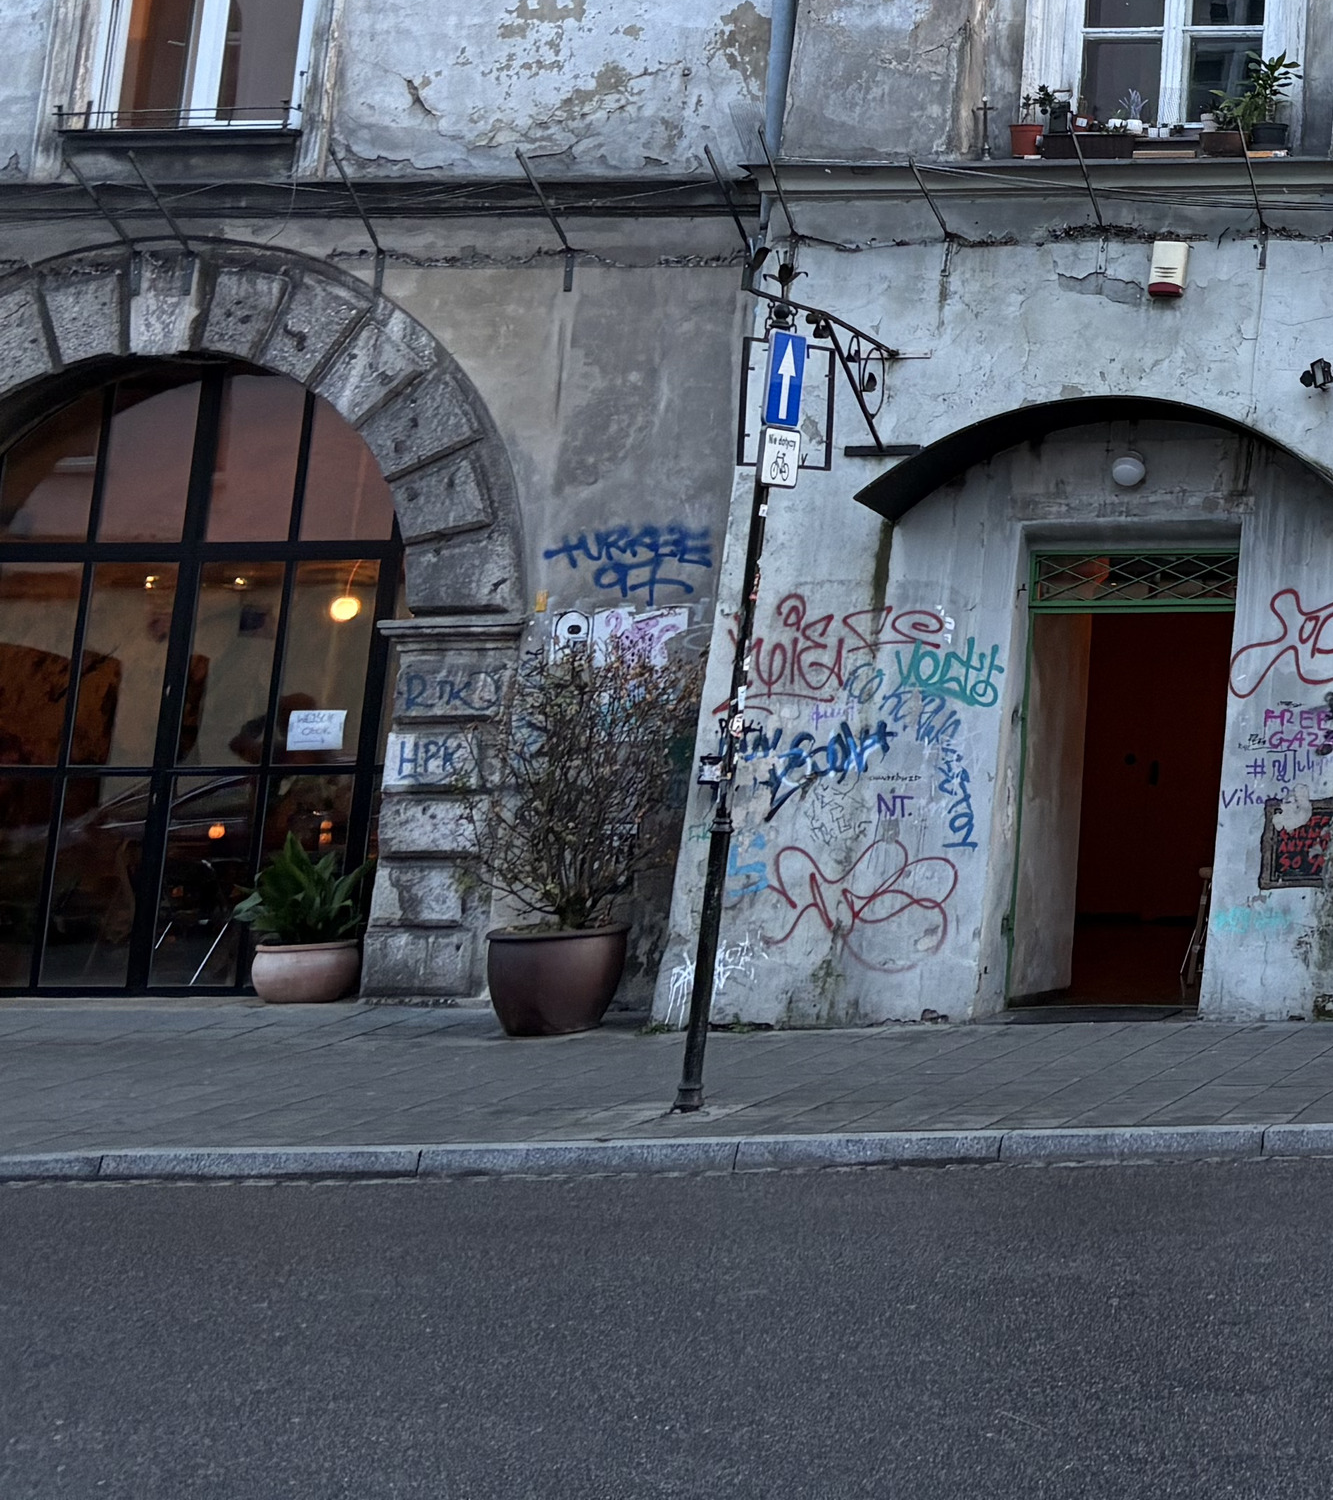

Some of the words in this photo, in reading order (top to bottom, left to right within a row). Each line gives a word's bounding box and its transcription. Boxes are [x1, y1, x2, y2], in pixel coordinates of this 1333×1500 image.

[768, 434, 778, 445] Nie
[778, 435, 797, 451] dotyczy
[1263, 708, 1333, 733] FREE
